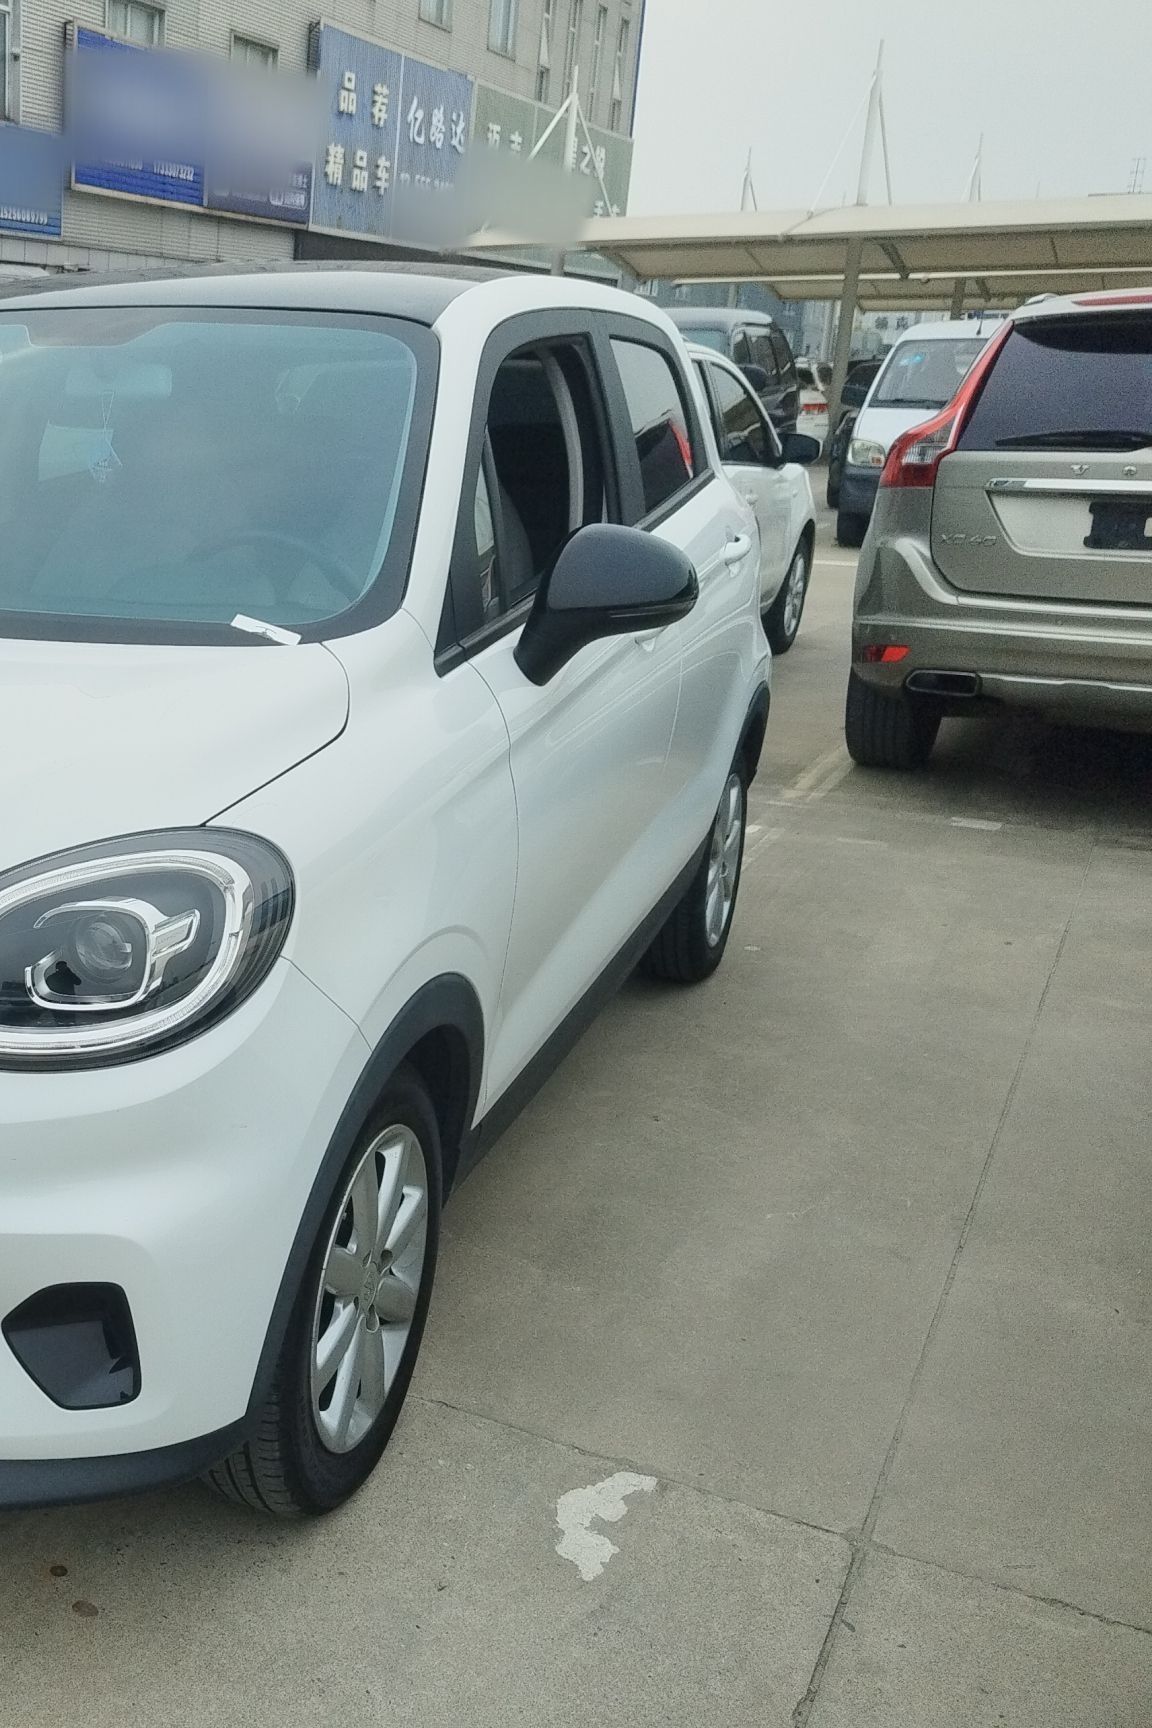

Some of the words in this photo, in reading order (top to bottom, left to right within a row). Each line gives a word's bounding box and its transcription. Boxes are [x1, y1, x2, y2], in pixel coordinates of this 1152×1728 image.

[338, 71, 389, 128] 品荐
[325, 142, 391, 196] 精品车
